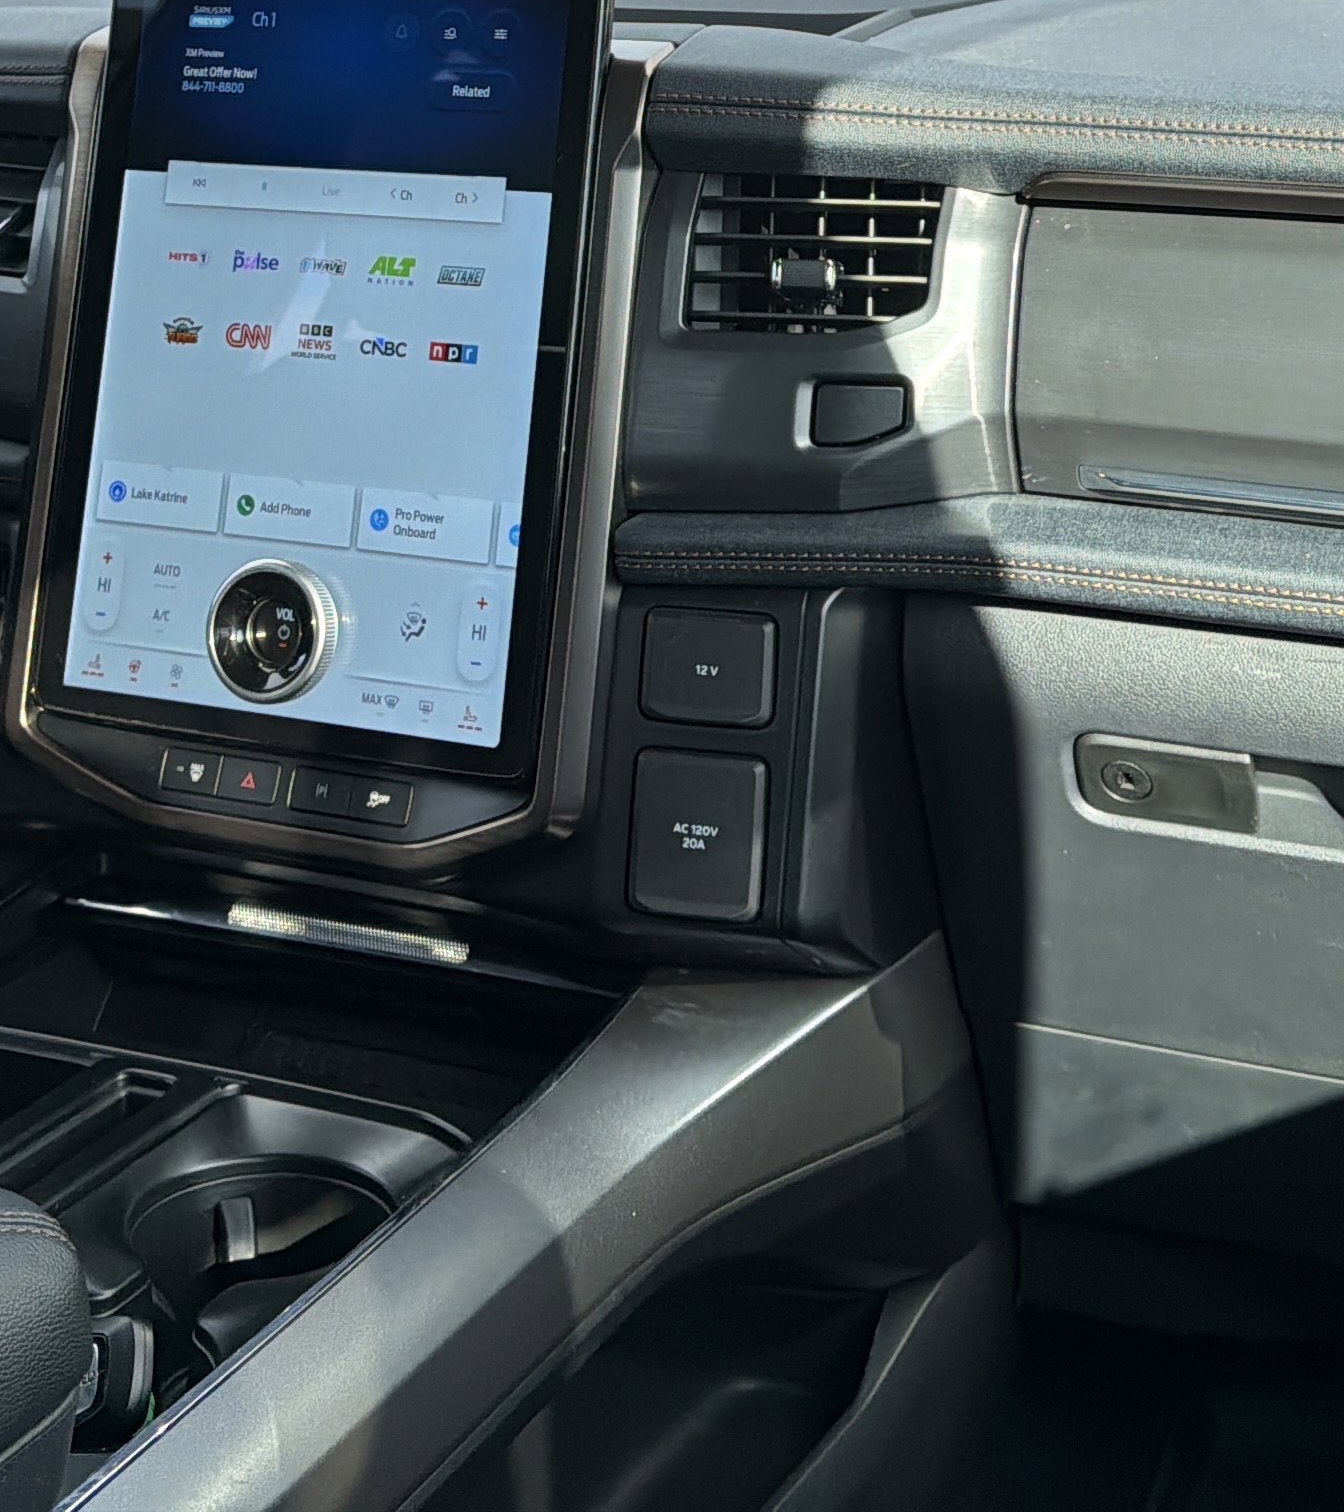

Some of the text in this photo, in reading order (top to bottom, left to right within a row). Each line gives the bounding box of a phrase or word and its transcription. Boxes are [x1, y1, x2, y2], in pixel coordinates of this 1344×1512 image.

[252, 12, 268, 27] Ch
[183, 66, 258, 80] Great Offer Now!
[452, 84, 490, 98] Related
[400, 190, 413, 202] Ch
[455, 192, 468, 204] Ch
[168, 252, 198, 262] HITS
[232, 252, 280, 272] pulse
[368, 256, 416, 278] ALT
[441, 268, 481, 284] OCTANE
[226, 322, 272, 350] CNN
[298, 338, 332, 351] NEWS
[360, 338, 408, 358] CNBC
[432, 344, 474, 360] npr
[131, 486, 188, 504] Lake Katrine
[260, 501, 312, 518] Add Phone
[394, 508, 445, 525] Pro Power
[393, 524, 437, 540] Onboard
[154, 563, 181, 578] AUTO
[96, 576, 112, 594] HI
[152, 608, 171, 622] A/C
[276, 607, 296, 622] VOL
[471, 624, 487, 642] HI
[695, 664, 719, 676] 12 V
[361, 692, 382, 706] MAX
[673, 822, 719, 837] AC 120V
[682, 838, 706, 850] 20A
